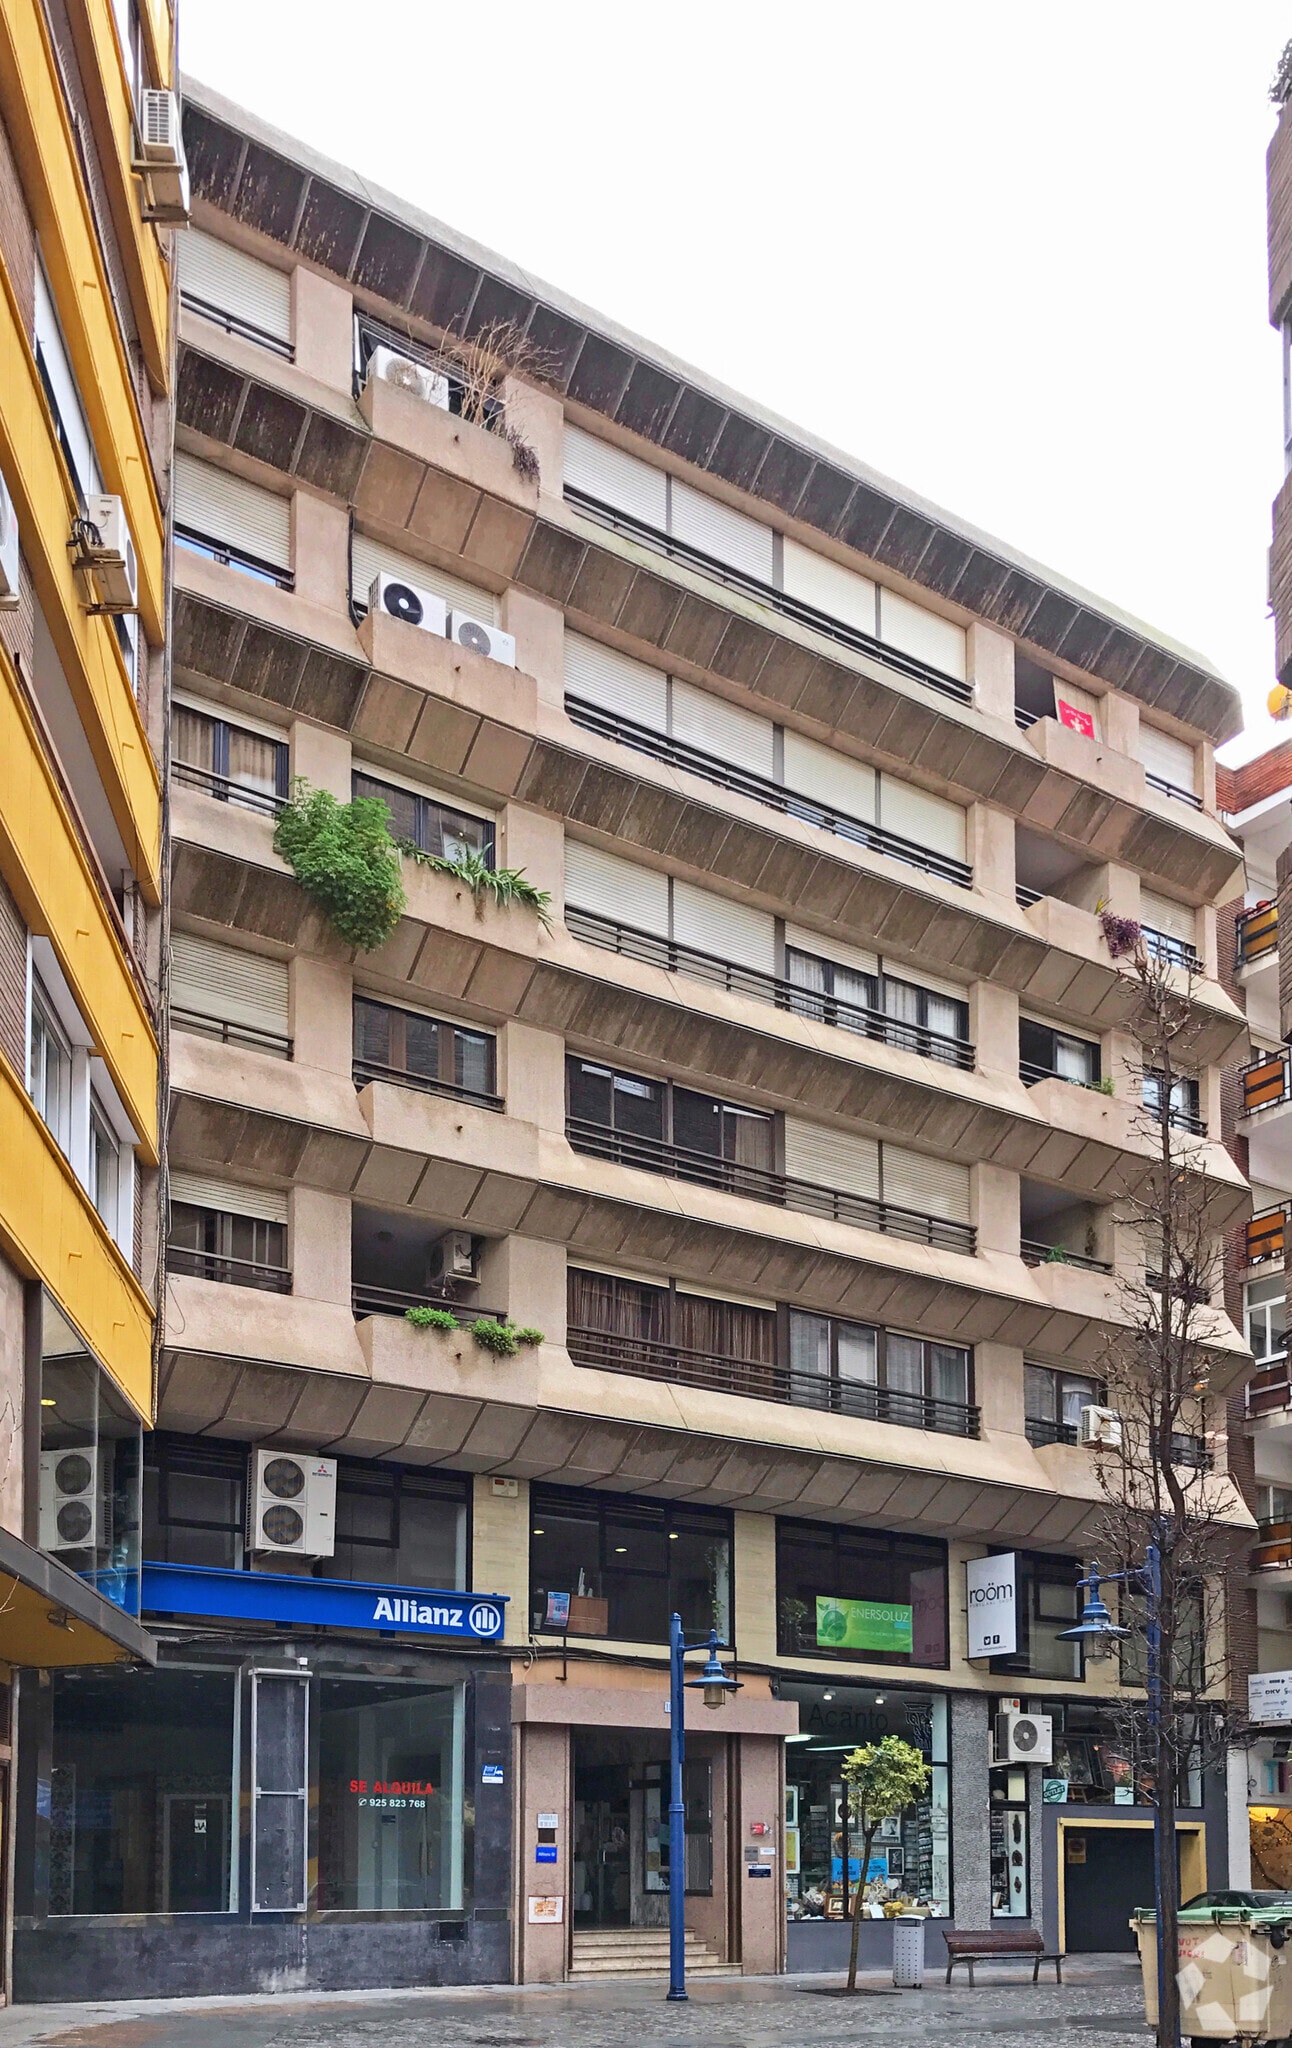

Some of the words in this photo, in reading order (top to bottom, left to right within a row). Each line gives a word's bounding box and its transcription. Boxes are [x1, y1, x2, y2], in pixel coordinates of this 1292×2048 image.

[969, 1582, 1013, 1604] roöm
[372, 1596, 464, 1627] Allianz
[850, 1607, 910, 1623] ENERSOLUZ
[808, 1703, 888, 1731] Acanto
[349, 1779, 368, 1793] SE
[373, 1780, 434, 1795] ALQUILA
[1043, 1786, 1065, 1798] OUTLET
[369, 1798, 387, 1807] 925
[389, 1799, 407, 1808] 823
[409, 1799, 426, 1808] 768
